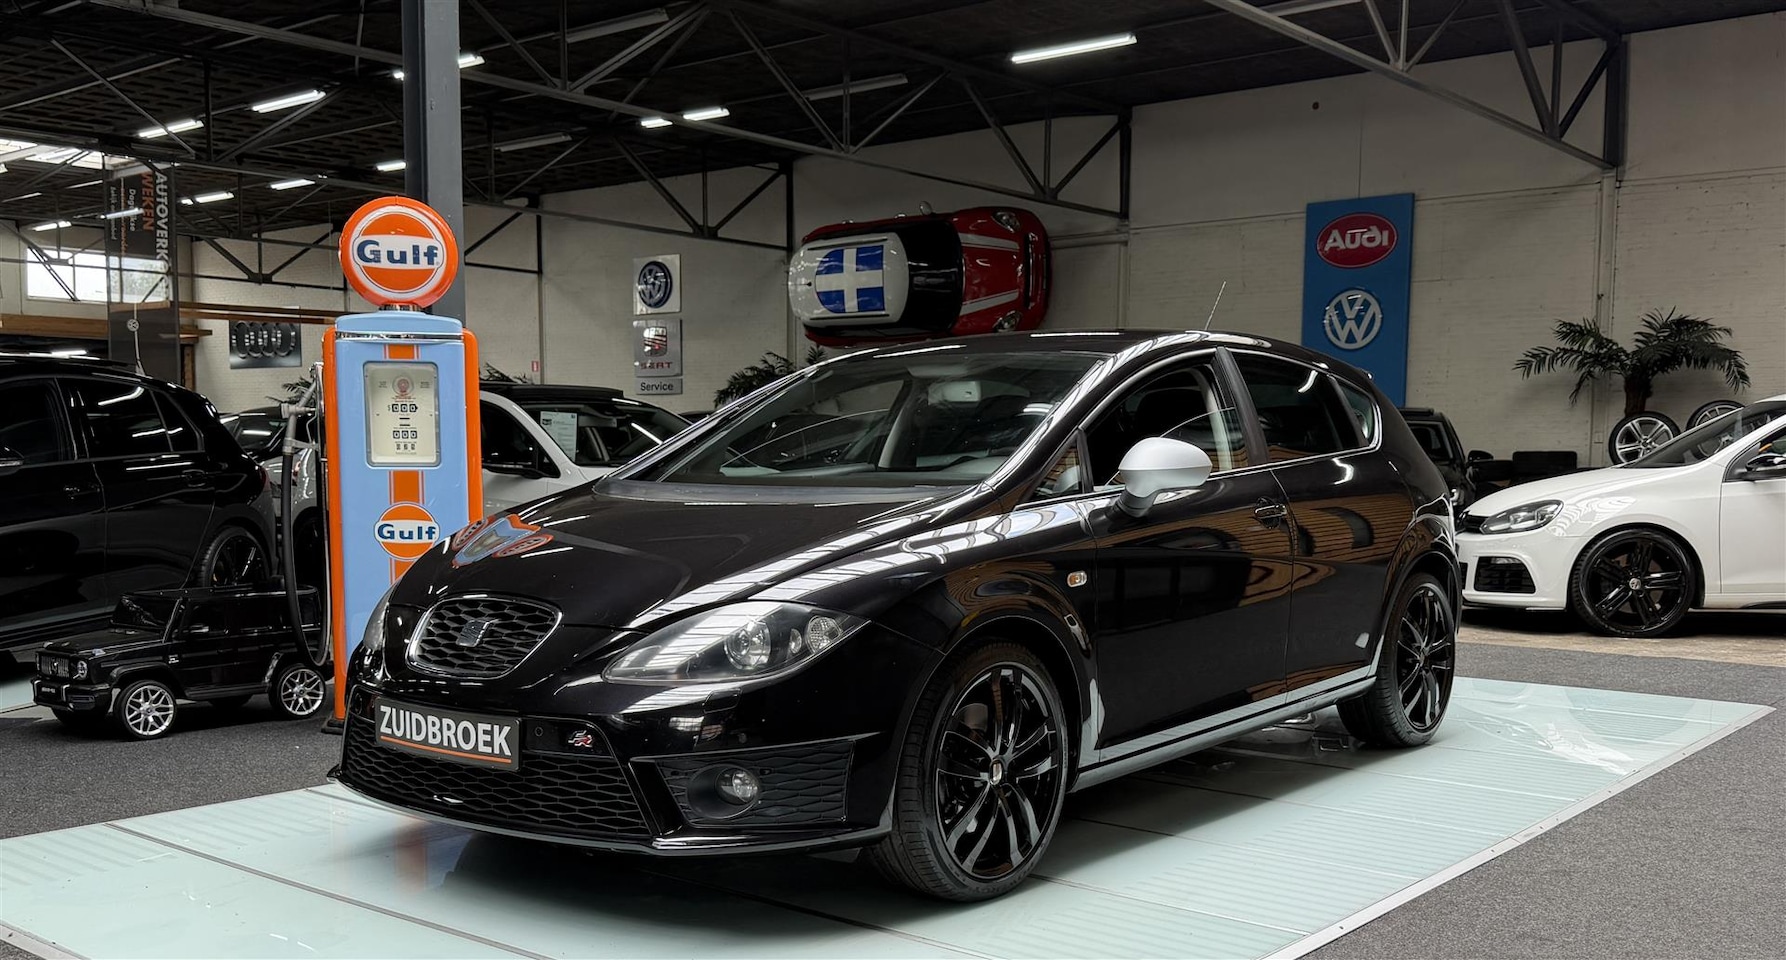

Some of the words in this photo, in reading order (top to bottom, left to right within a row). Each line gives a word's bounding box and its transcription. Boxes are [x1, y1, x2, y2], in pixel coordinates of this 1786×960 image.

[141, 171, 154, 231] WEKEN
[357, 239, 438, 266] Gulf
[640, 381, 674, 391] Service
[377, 523, 437, 541] Gulf
[379, 705, 512, 756] ZUIDBROEK
